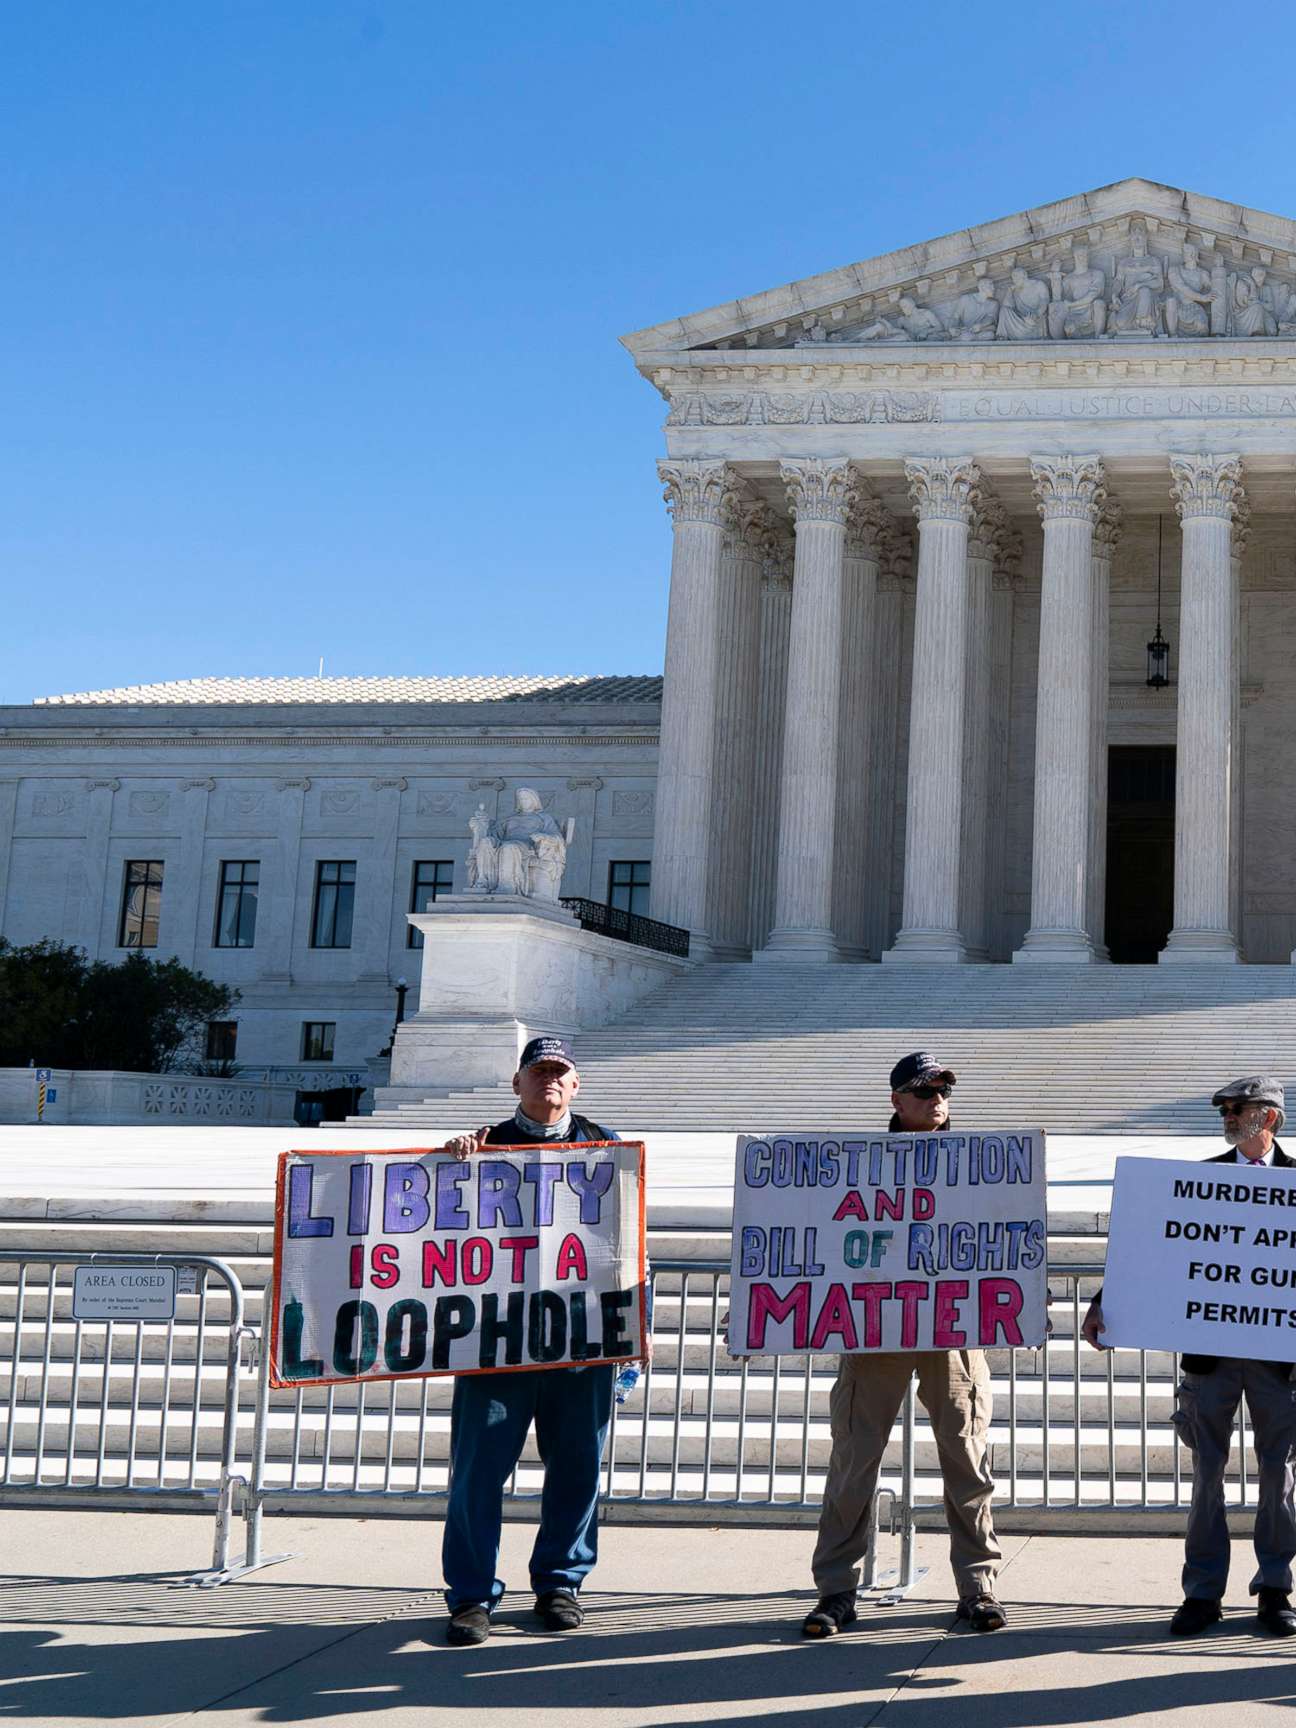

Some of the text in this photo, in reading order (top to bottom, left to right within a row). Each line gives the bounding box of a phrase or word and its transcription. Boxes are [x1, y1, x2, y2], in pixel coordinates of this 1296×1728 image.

[959, 399, 1045, 417] EQUAL
[1054, 396, 1153, 416] JUSTICE
[1167, 395, 1256, 414] UNDER
[744, 1136, 1032, 1188] CONSTITUTION
[287, 1160, 614, 1238] LIBERTY
[832, 1188, 936, 1221] AND
[740, 1220, 1045, 1278] BILL OF RIGHTS
[1165, 1220, 1246, 1244] DON'T
[84, 1275, 165, 1287] AREA CLOSED
[349, 1233, 588, 1289] IS NOT A
[1188, 1262, 1241, 1284] FOR
[283, 1289, 633, 1378] LOOPHOLE
[747, 1277, 1024, 1349] MATTER
